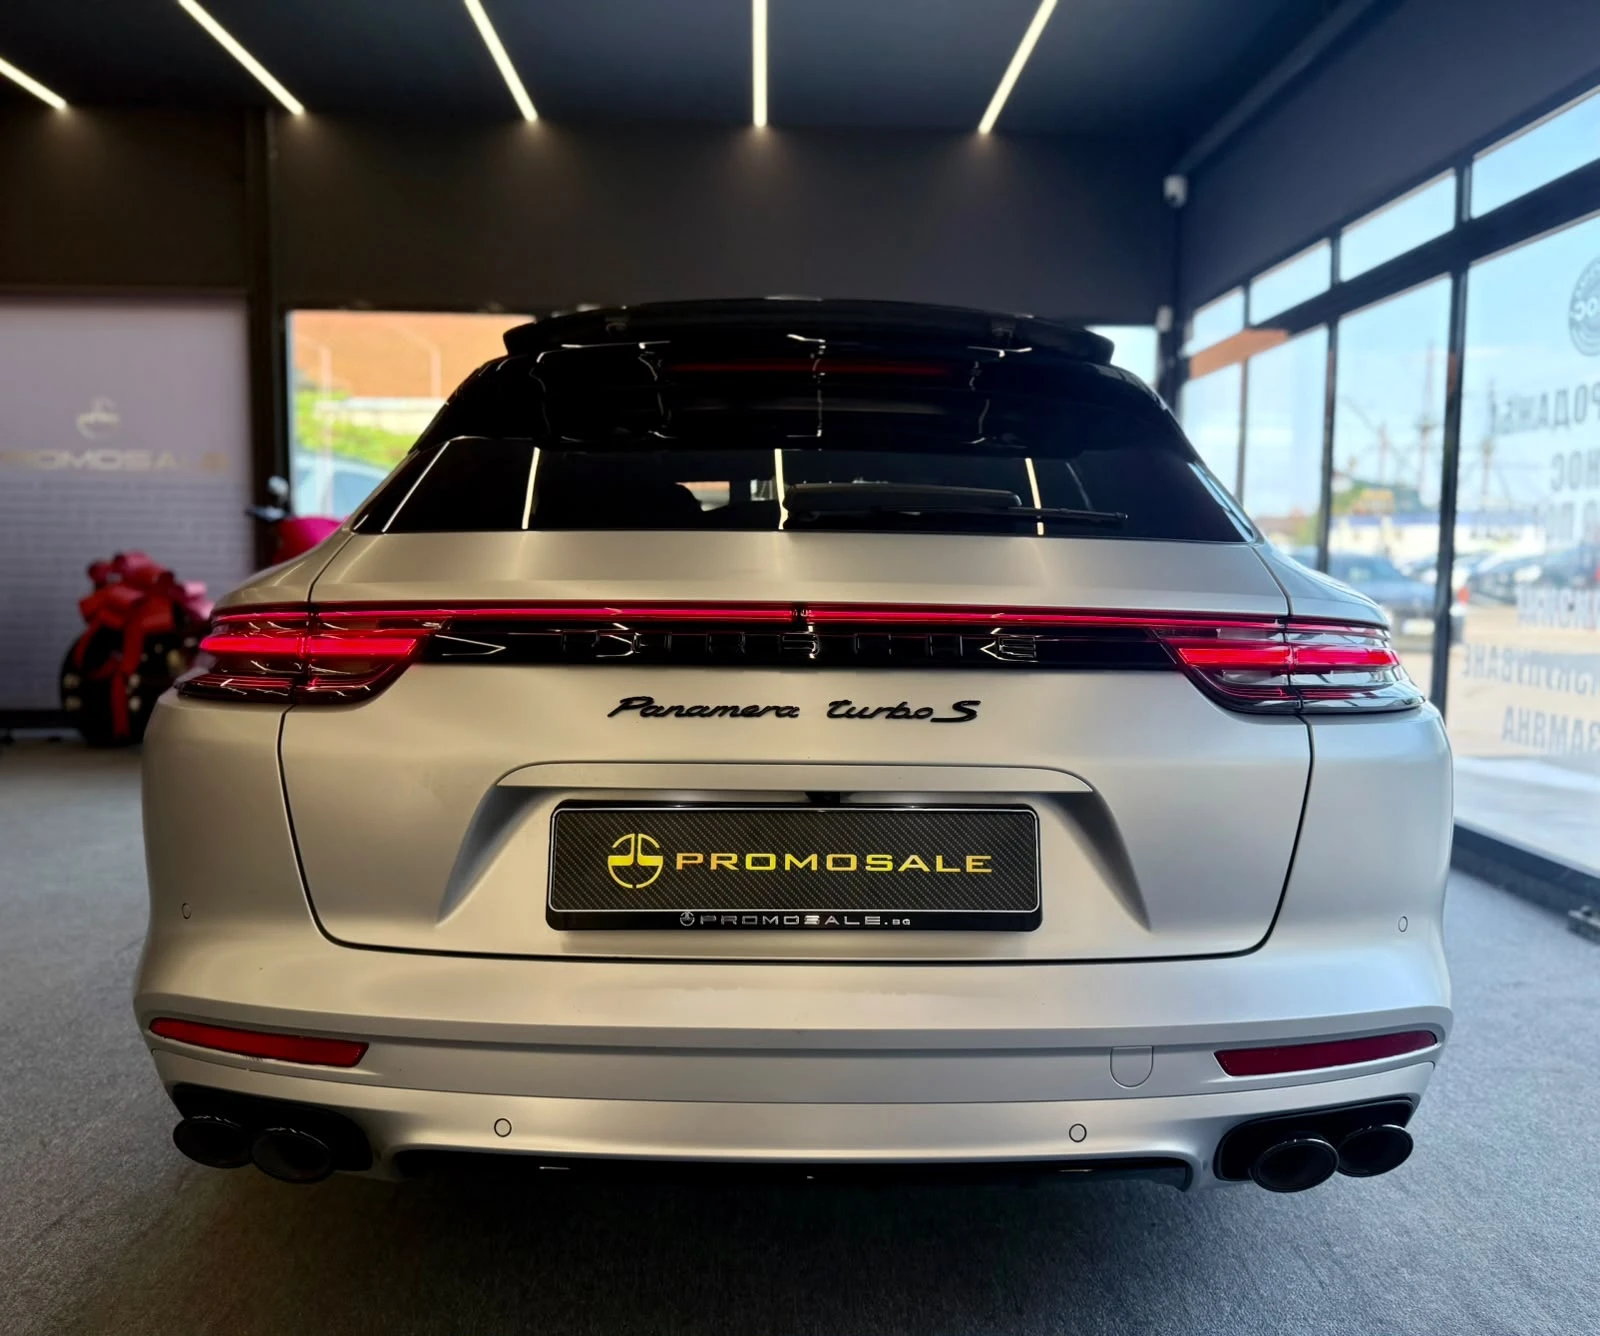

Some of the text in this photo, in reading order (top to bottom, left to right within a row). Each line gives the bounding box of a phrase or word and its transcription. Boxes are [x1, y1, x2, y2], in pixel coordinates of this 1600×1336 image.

[607, 696, 981, 722] Panamera turbo S
[675, 852, 993, 874] PROMOSALE
